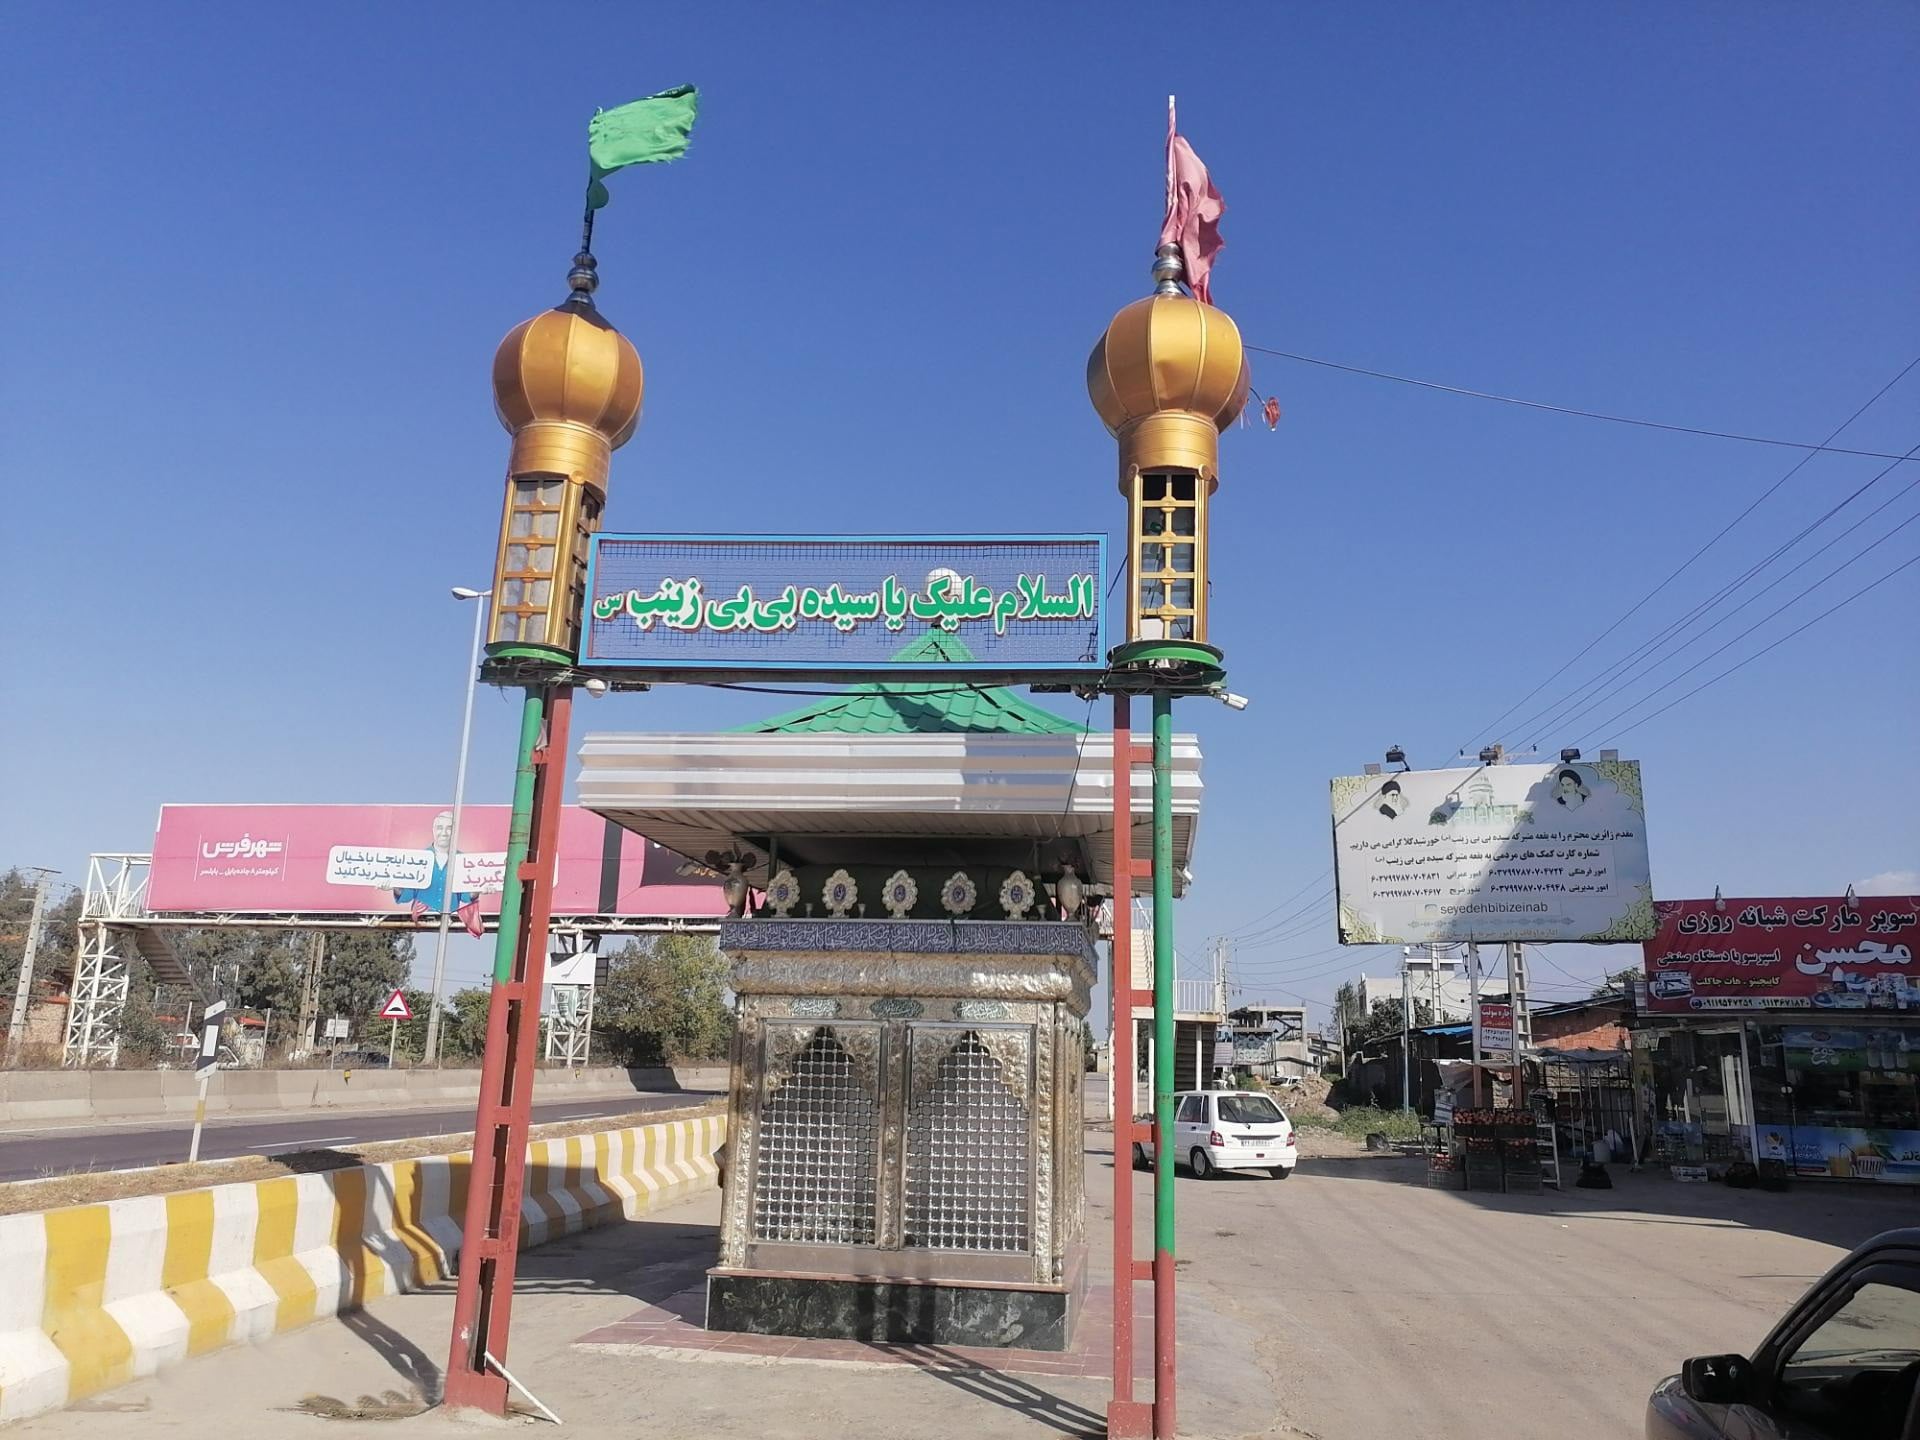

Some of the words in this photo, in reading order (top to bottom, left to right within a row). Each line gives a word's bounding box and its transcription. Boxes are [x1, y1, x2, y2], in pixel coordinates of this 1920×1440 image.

[593, 591, 623, 620] س
[628, 576, 702, 629] زینب
[752, 584, 798, 630] بی
[799, 581, 879, 631] سیده
[881, 572, 905, 630] یا
[910, 574, 995, 631] علیک
[994, 571, 1094, 636] السلام
[706, 584, 751, 632] بی
[1550, 832, 1557, 841] به
[1559, 831, 1566, 841] را
[1567, 831, 1589, 842] محترم
[1591, 828, 1614, 841] زائرین
[1615, 830, 1634, 841] مقدم
[1370, 841, 1381, 851] می
[1382, 838, 1402, 850] گرامی
[335, 850, 365, 864] خیال
[366, 852, 374, 864] با
[1426, 854, 1443, 863] سیده
[1493, 852, 1518, 862] مردمی
[1520, 850, 1535, 861] های
[1536, 848, 1555, 858] کمک
[1557, 848, 1576, 861] کارت
[1578, 848, 1599, 860] شماره
[376, 853, 406, 868] اینجا
[407, 857, 428, 867] بعد
[1386, 856, 1403, 866] زینب
[1405, 856, 1414, 866] بی
[1416, 855, 1425, 865] بی
[335, 866, 360, 877] کنید
[362, 867, 390, 879] خرید
[393, 870, 426, 883] راحت
[1568, 867, 1592, 878] فرهنگی
[1595, 867, 1606, 877] امور
[1596, 883, 1609, 893] امور
[1440, 902, 1548, 916] seyedehbibizeinab
[1678, 911, 1734, 934] روزی
[1738, 905, 1788, 932] شبانه
[1866, 910, 1917, 933] سوپر
[1657, 951, 1691, 967] صنعتی
[1693, 948, 1730, 963] دستگاه
[1731, 948, 1740, 965] با
[1796, 940, 1912, 975] محسن
